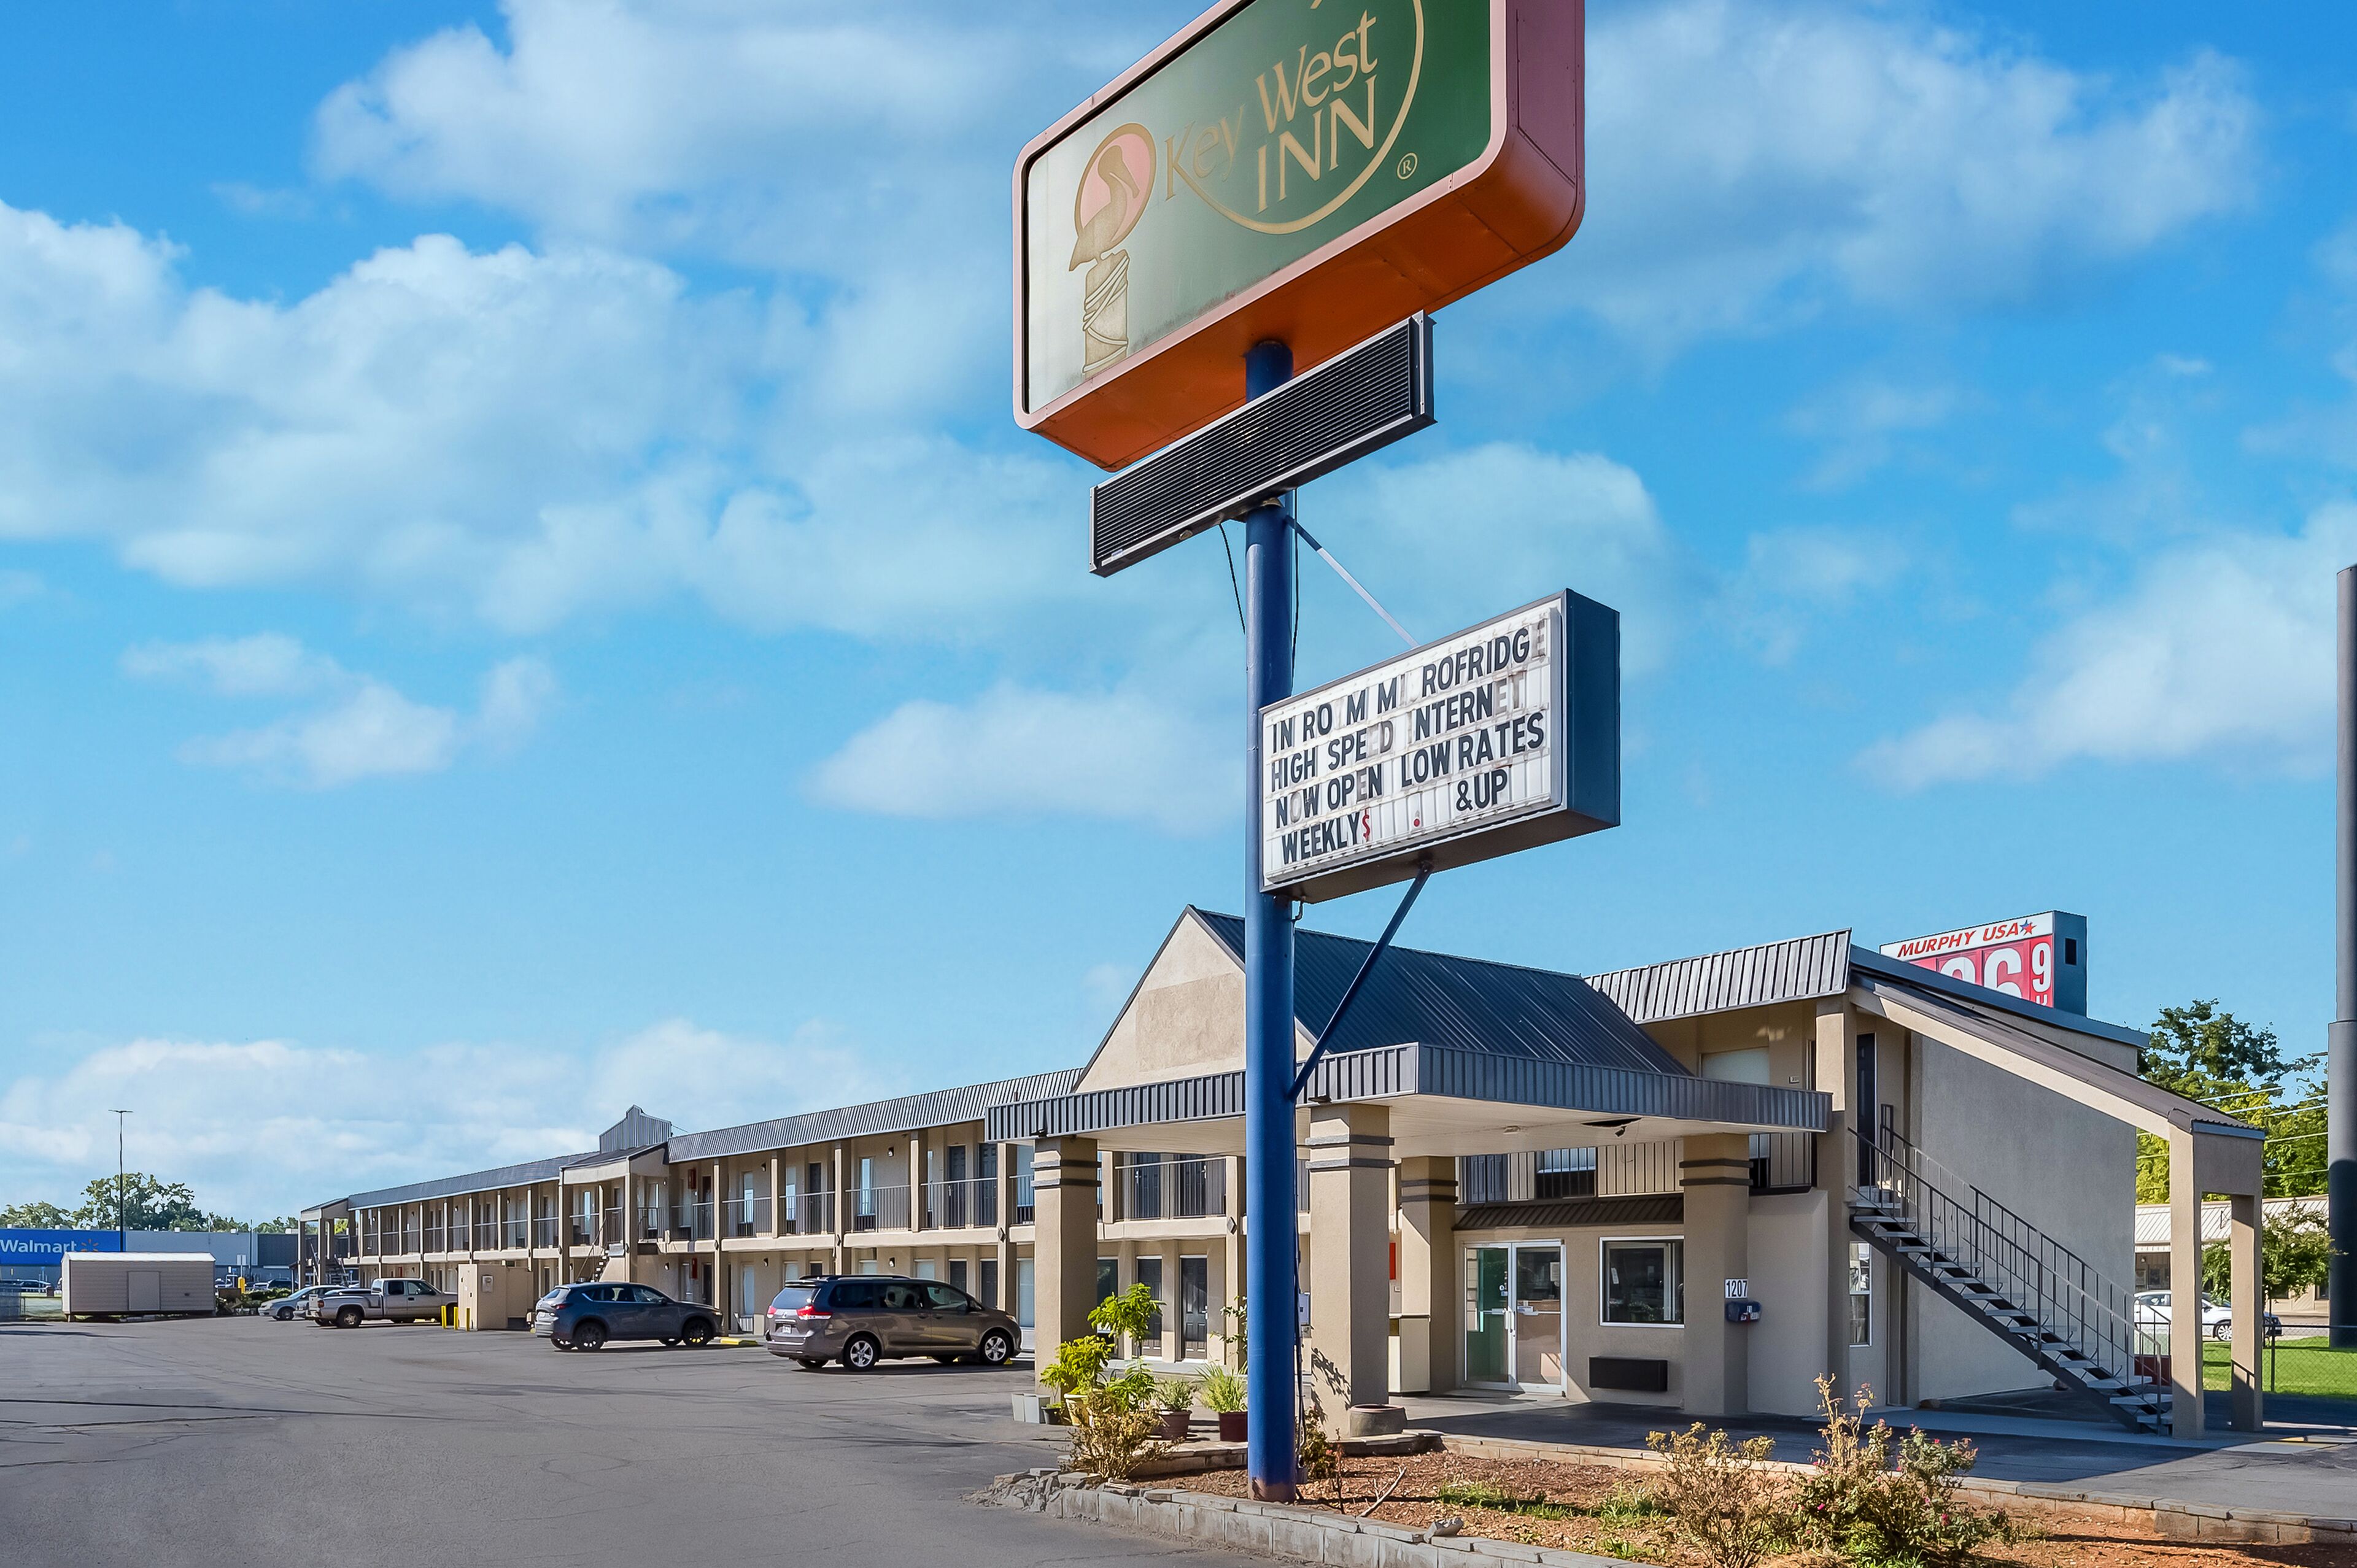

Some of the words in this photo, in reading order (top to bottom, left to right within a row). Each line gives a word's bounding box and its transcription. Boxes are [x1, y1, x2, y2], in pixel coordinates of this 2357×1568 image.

[1166, 104, 1245, 201] Key
[1255, 9, 1378, 134] West
[1257, 74, 1377, 215] INN
[1273, 717, 1293, 754] IN
[1271, 746, 1315, 793] HIGH
[1276, 784, 1318, 829] NOW
[1328, 763, 1382, 810] OPEN
[1401, 740, 1450, 787] LOW
[1458, 712, 1544, 770] RATES
[1897, 930, 1976, 958] MURPHY
[1983, 922, 2019, 941] USA
[0, 1239, 77, 1253] Walmart
[1726, 1280, 1747, 1297] 1207
